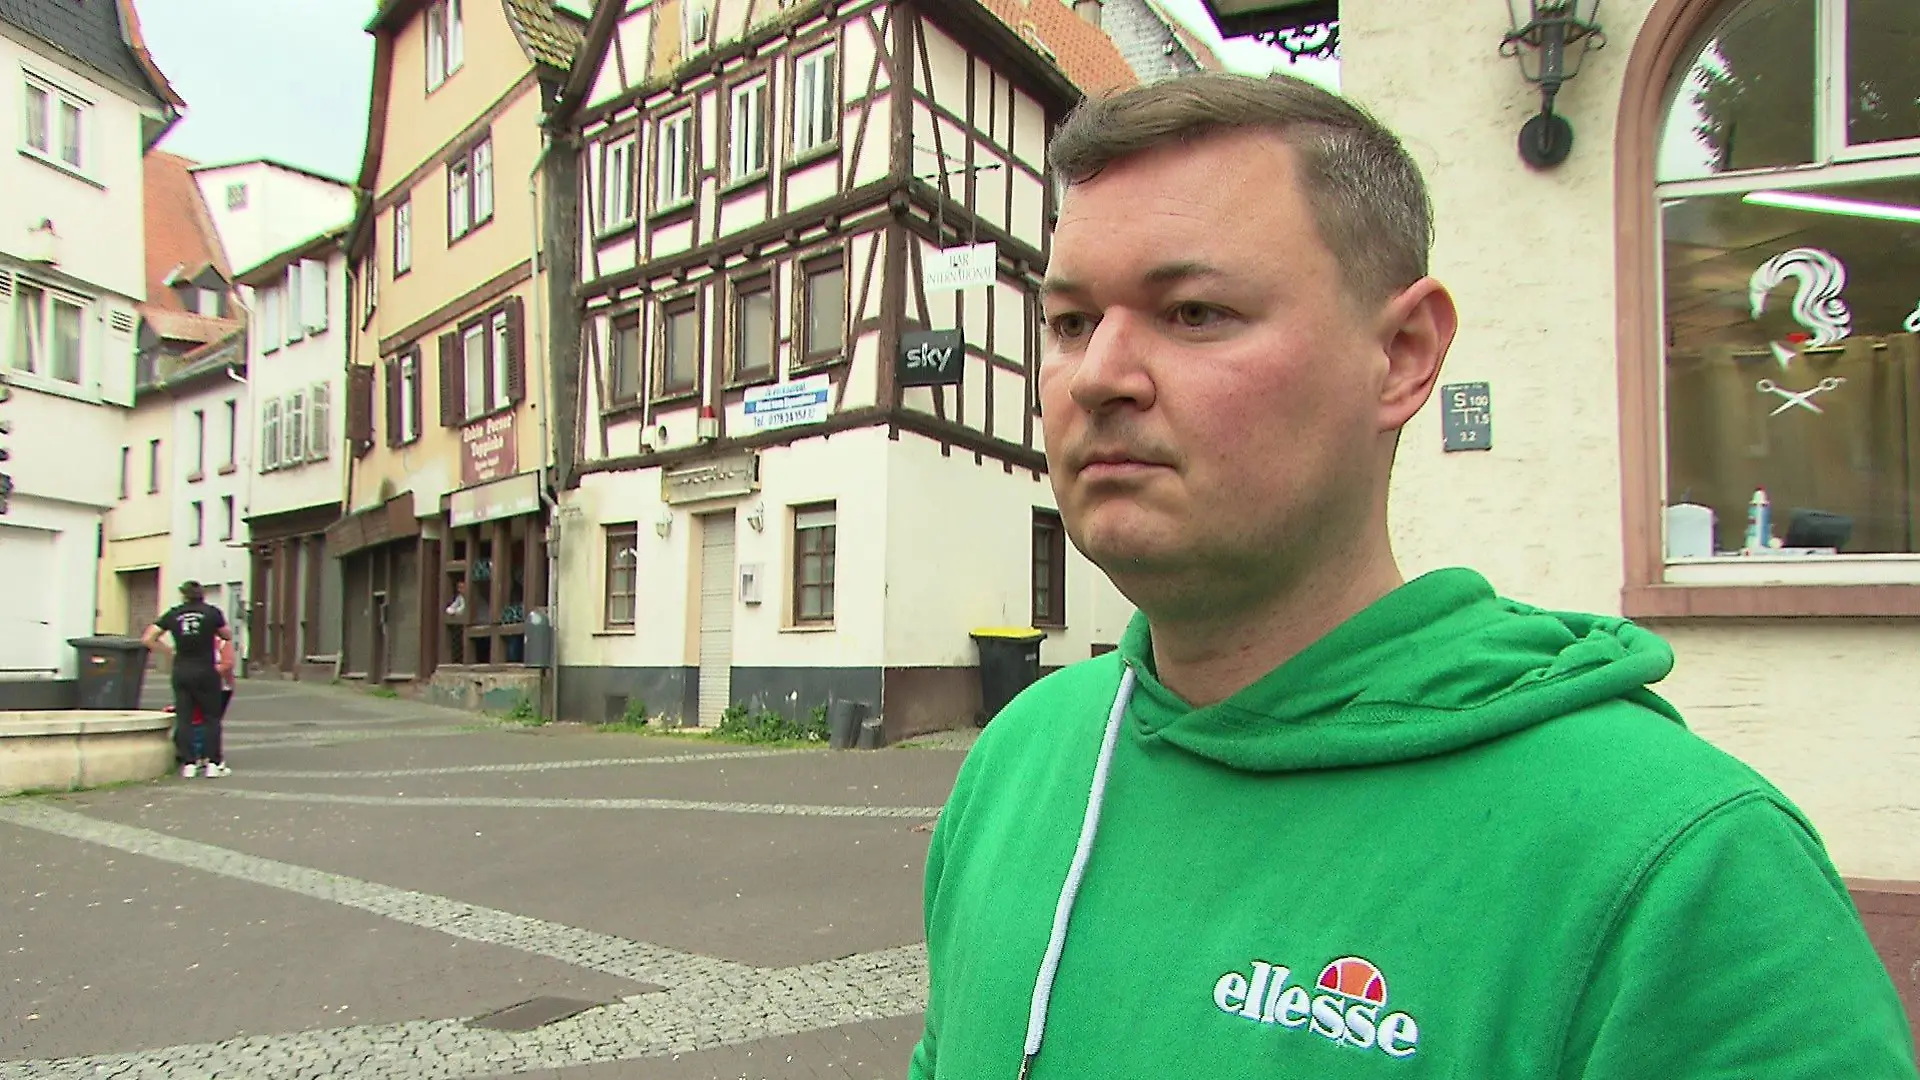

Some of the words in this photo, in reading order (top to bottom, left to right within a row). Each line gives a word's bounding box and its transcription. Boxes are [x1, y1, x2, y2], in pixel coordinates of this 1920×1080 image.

[949, 253, 969, 268] BAR
[906, 342, 953, 373] sky
[1453, 391, 1467, 407] S
[1469, 395, 1489, 406] 100
[1212, 959, 1419, 1059] ellesse
